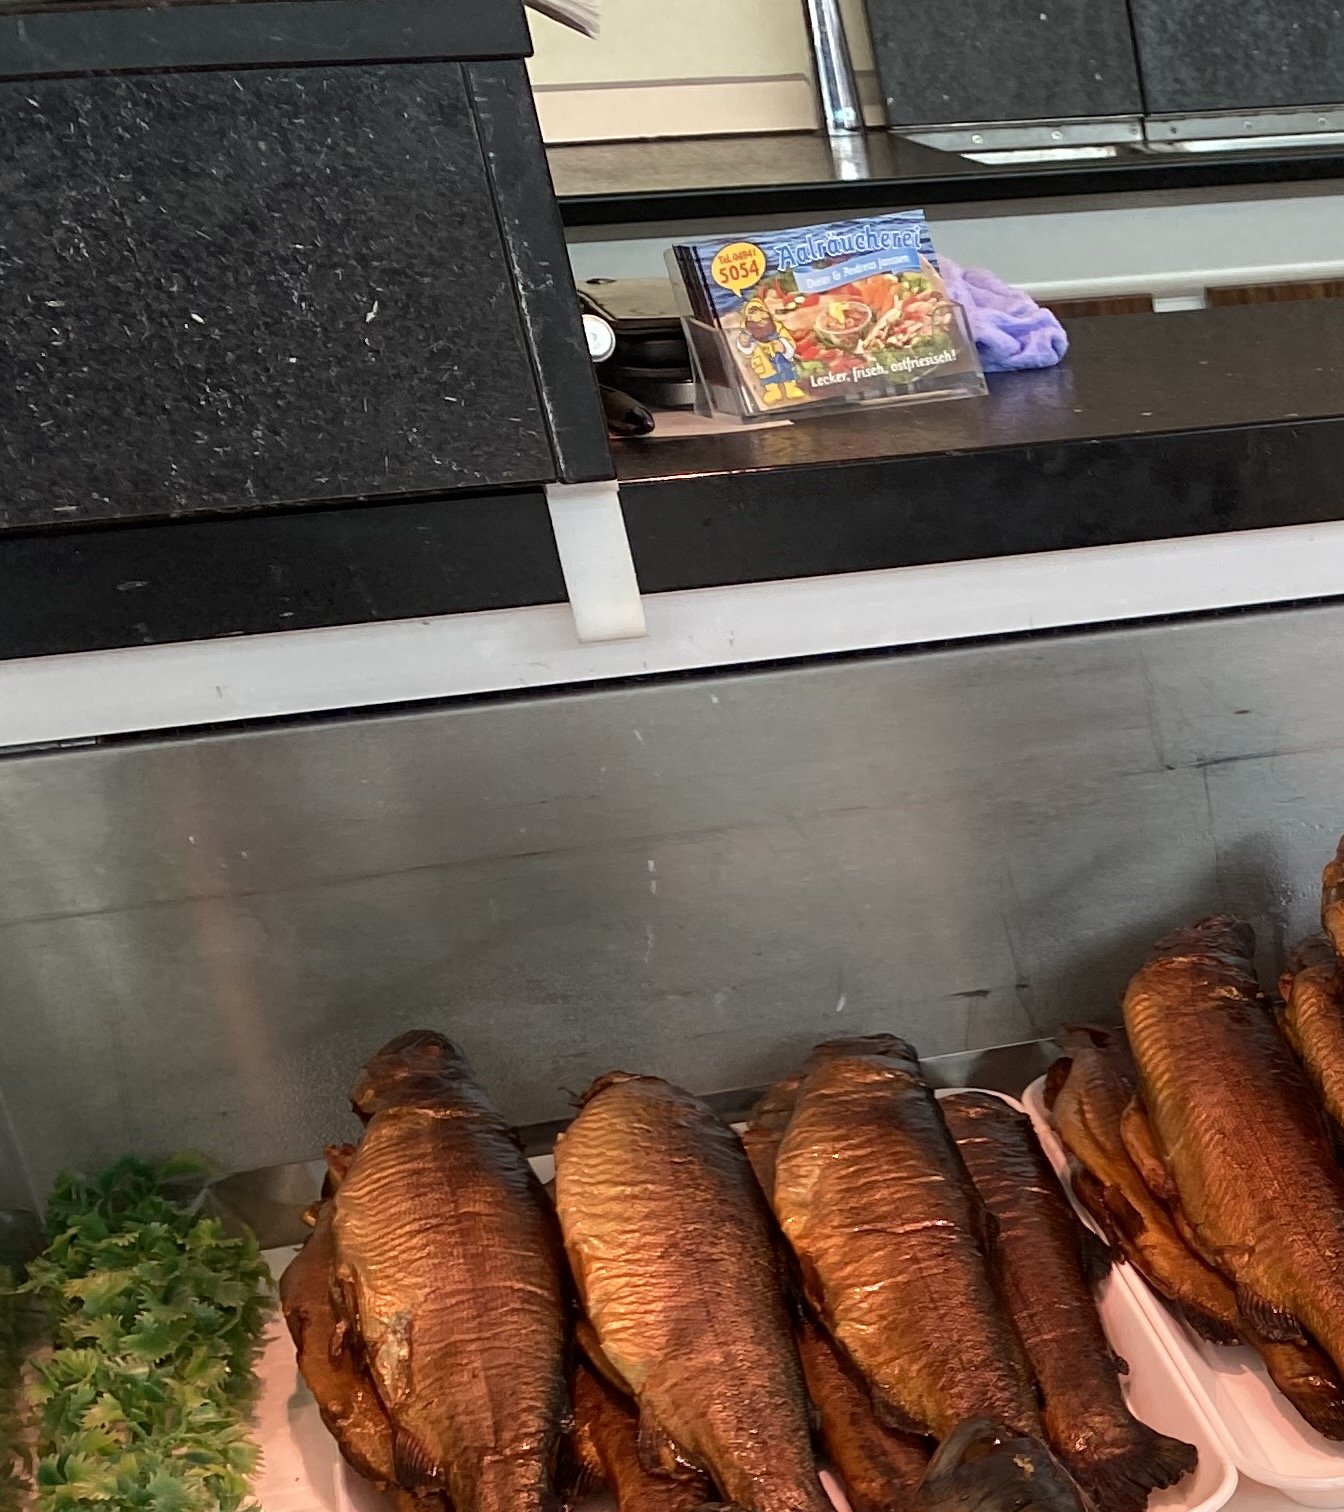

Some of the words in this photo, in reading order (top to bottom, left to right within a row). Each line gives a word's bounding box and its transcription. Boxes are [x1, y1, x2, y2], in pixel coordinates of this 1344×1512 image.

[775, 225, 921, 270] Aalräucherei
[719, 259, 760, 284] 5054
[809, 373, 851, 388] Lecker,
[852, 363, 889, 383] frisch,
[891, 349, 957, 373] ostfriesisch!
